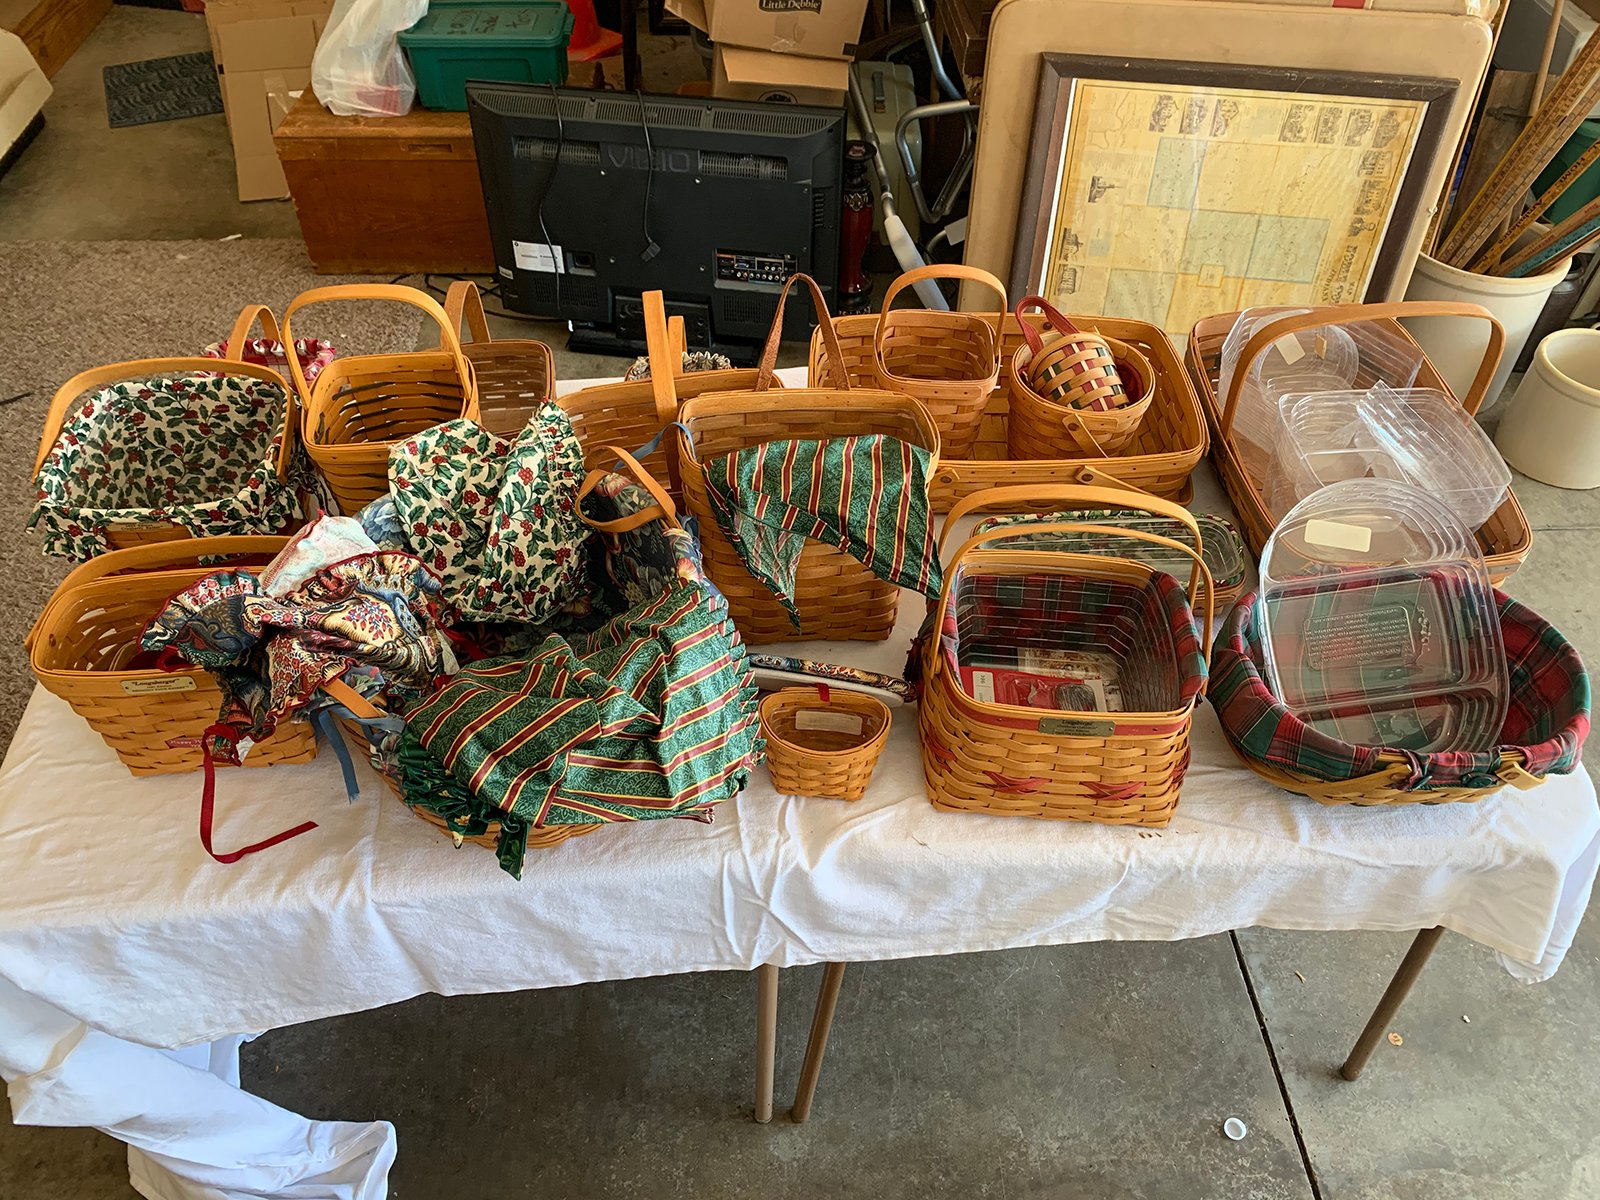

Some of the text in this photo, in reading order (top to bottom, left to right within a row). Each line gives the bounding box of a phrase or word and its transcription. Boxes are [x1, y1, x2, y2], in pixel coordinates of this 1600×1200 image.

[762, 0, 819, 9] Little Debbie
[607, 146, 690, 173] VIZIO
[1498, 199, 1543, 244] Ambulance
